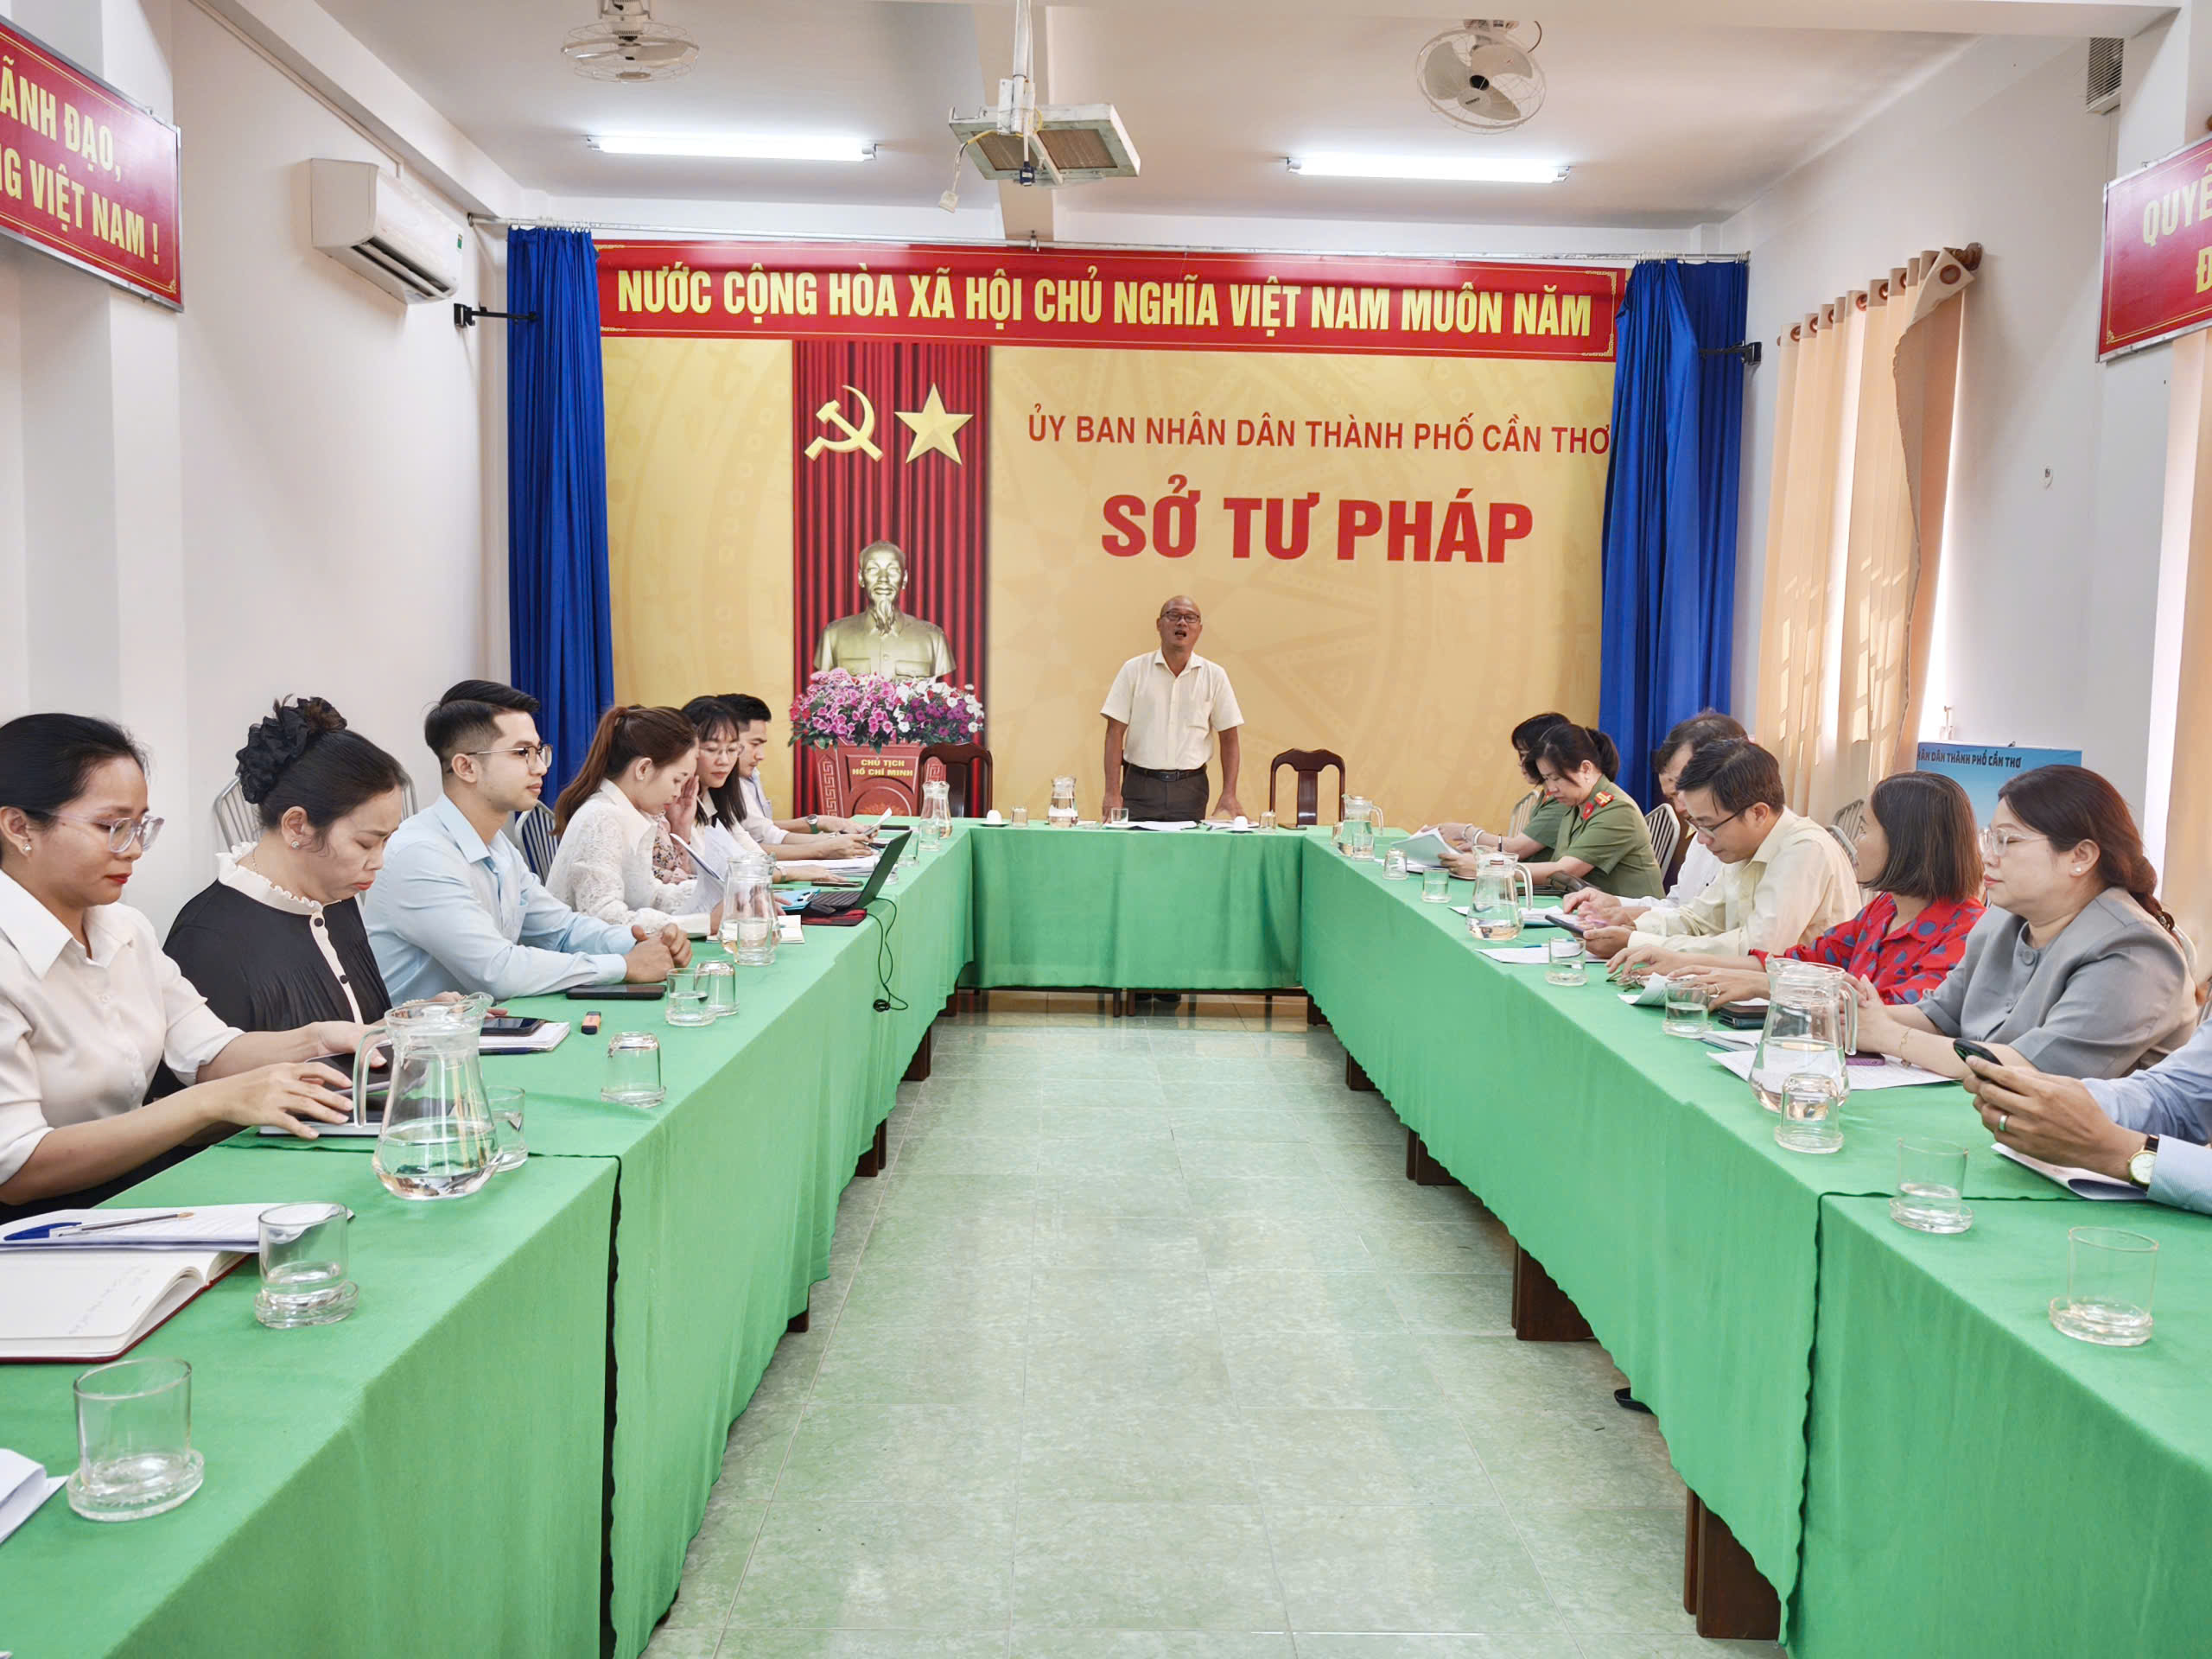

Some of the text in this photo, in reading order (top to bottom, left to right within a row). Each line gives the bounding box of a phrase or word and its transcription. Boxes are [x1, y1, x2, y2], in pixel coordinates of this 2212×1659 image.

[0, 55, 121, 182] ÃNH ĐẠO,
[29, 158, 85, 232] VIỆT
[92, 192, 145, 258] NAM
[618, 262, 1592, 337] NƯỚC CỘNG HÒA XÃ HỘI CHỦ NGHĨA VIỆT NAM MUÔN NĂM
[1028, 404, 1610, 455] ỦY BAN NHÂN DÂN THÀNH PHỐ CẦN THƠ
[1102, 474, 1534, 563] SỞ TƯ PHÁP
[1931, 749, 1945, 762] DÂN
[1947, 751, 1971, 765] THÀNH
[1971, 749, 1987, 766] PHỐ
[1988, 751, 2004, 767] CẦN
[2005, 757, 2022, 768] THƠ
